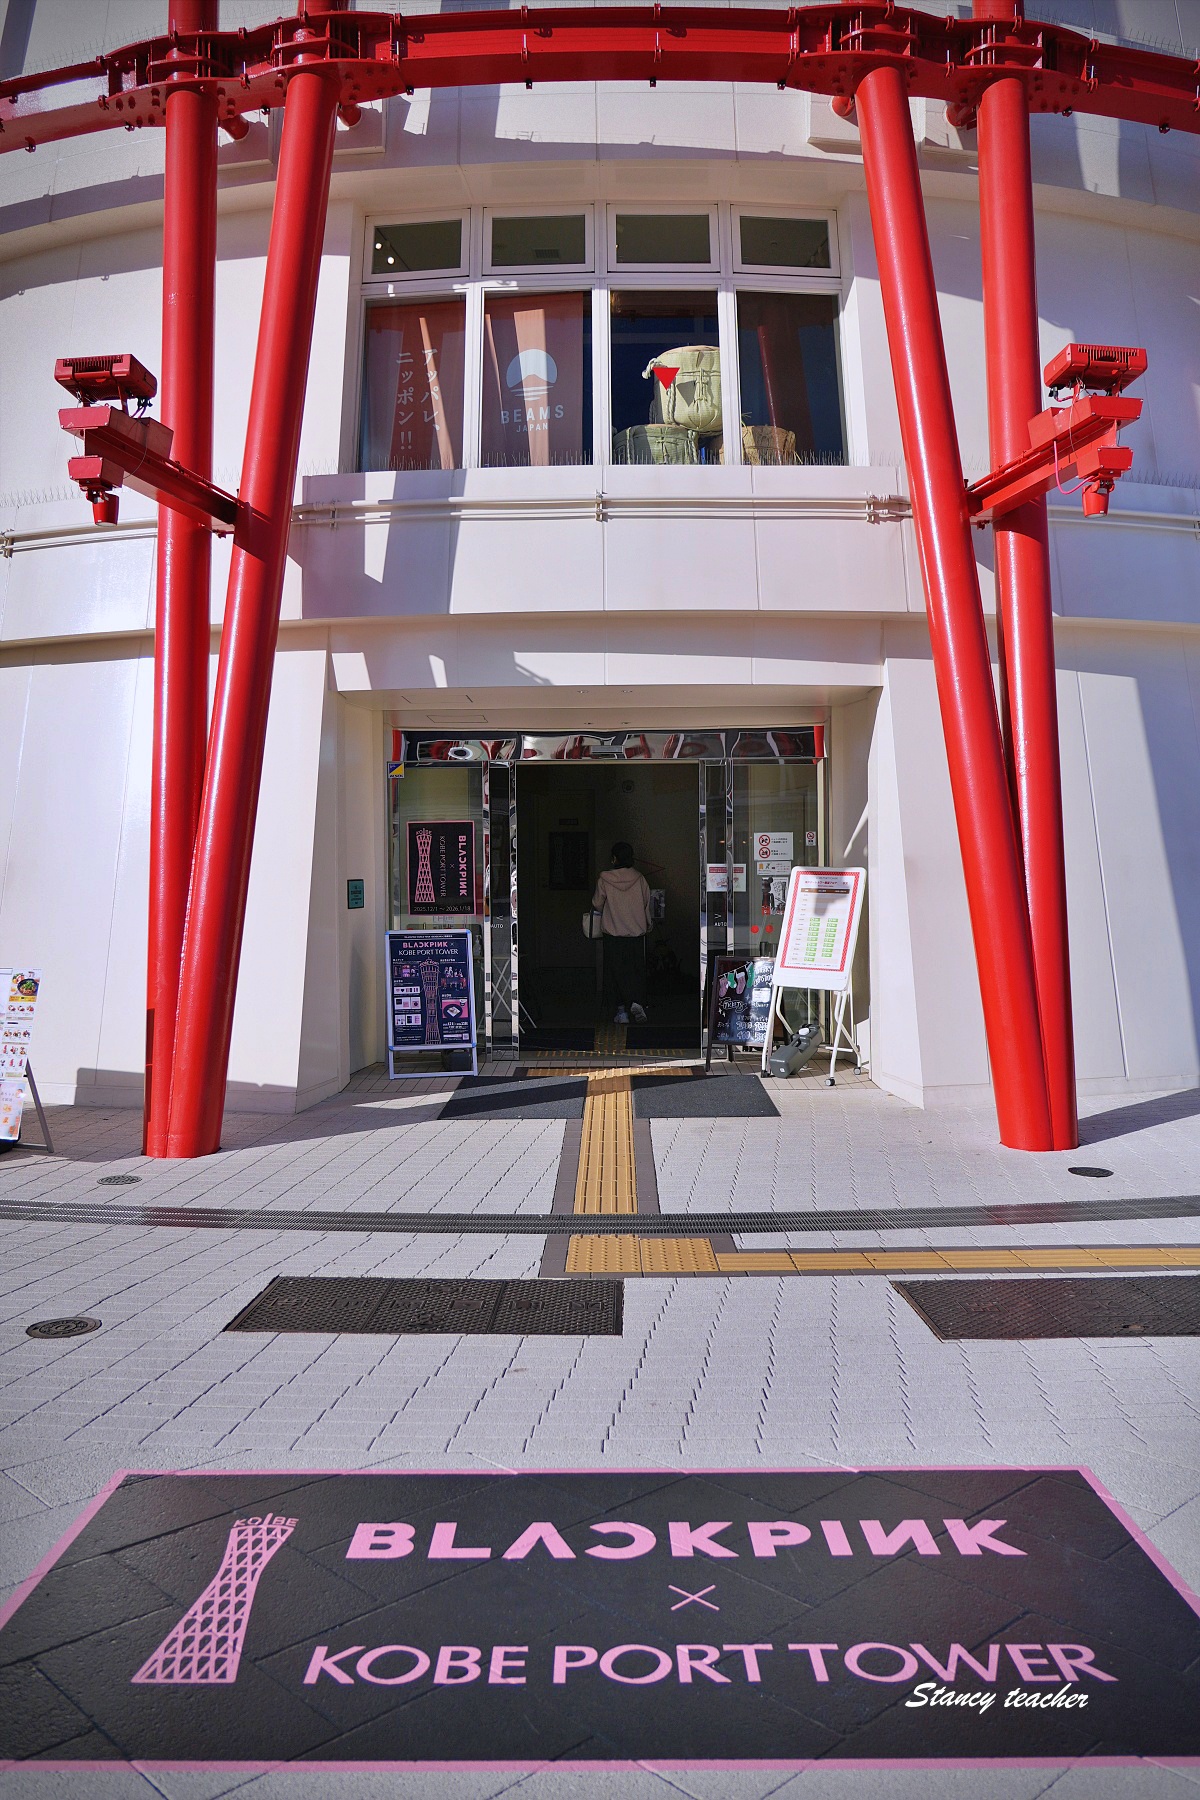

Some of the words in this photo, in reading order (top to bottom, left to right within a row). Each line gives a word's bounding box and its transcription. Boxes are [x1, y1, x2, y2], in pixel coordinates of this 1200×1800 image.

[421, 348, 440, 431] アッパレ、
[500, 405, 565, 425] BEAMS
[516, 422, 549, 433] JAPAN
[439, 871, 447, 897] TOWER
[303, 1645, 529, 1685] KOBE
[552, 1644, 774, 1685] PORT
[788, 1643, 1119, 1683] TOWER
